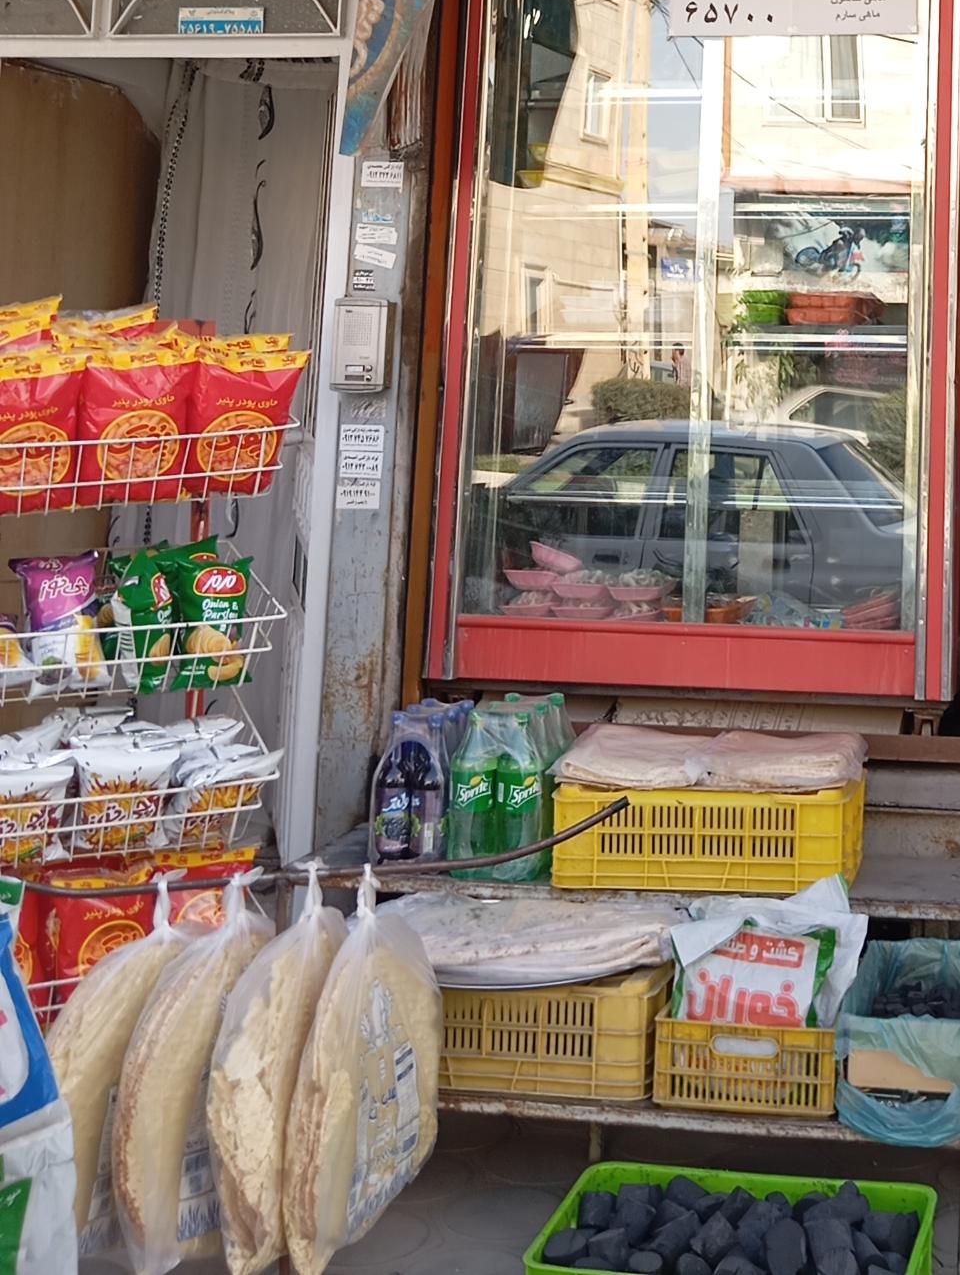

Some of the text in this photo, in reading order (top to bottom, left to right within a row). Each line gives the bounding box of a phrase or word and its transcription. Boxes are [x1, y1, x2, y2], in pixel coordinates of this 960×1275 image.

[685, 1, 774, 25] ۶۵۷۰۰
[858, 11, 881, 22] ماهی
[201, 569, 237, 594] مزمز
[202, 598, 239, 611] Onion &
[458, 779, 489, 802] Sprite
[748, 940, 758, 961] و
[761, 939, 800, 964] کشت
